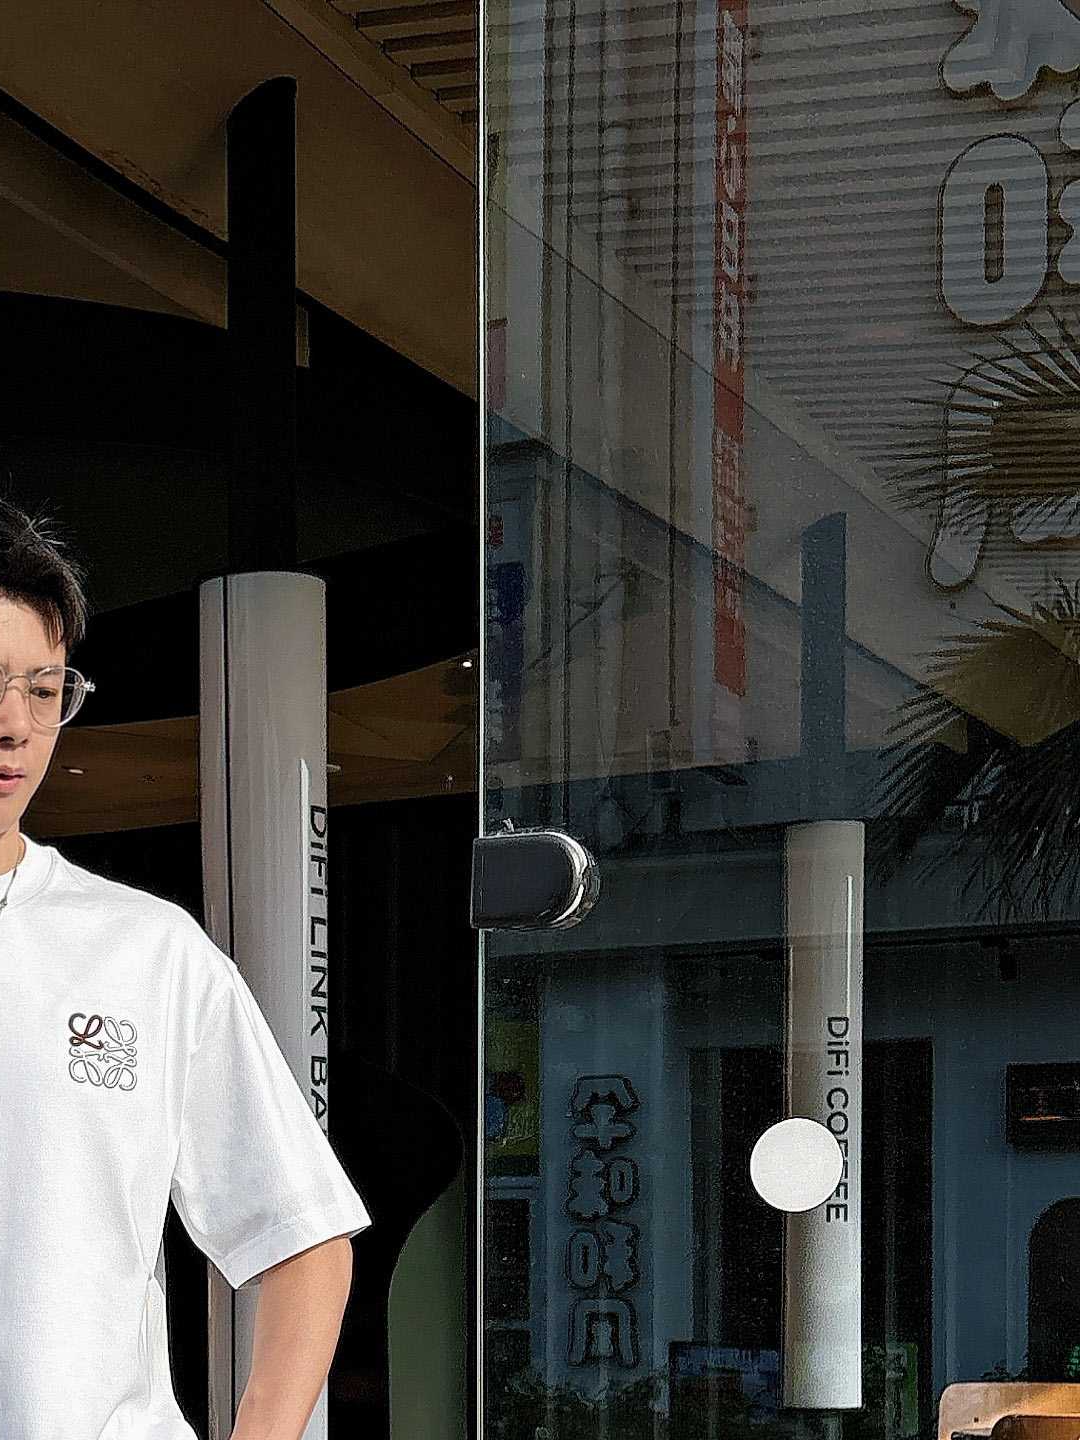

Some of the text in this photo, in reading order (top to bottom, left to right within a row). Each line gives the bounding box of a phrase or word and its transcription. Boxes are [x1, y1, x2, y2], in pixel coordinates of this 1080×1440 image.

[310, 916, 328, 1037] LINK
[310, 1055, 329, 1138] BA
[826, 1016, 850, 1223] DiFi COEE
